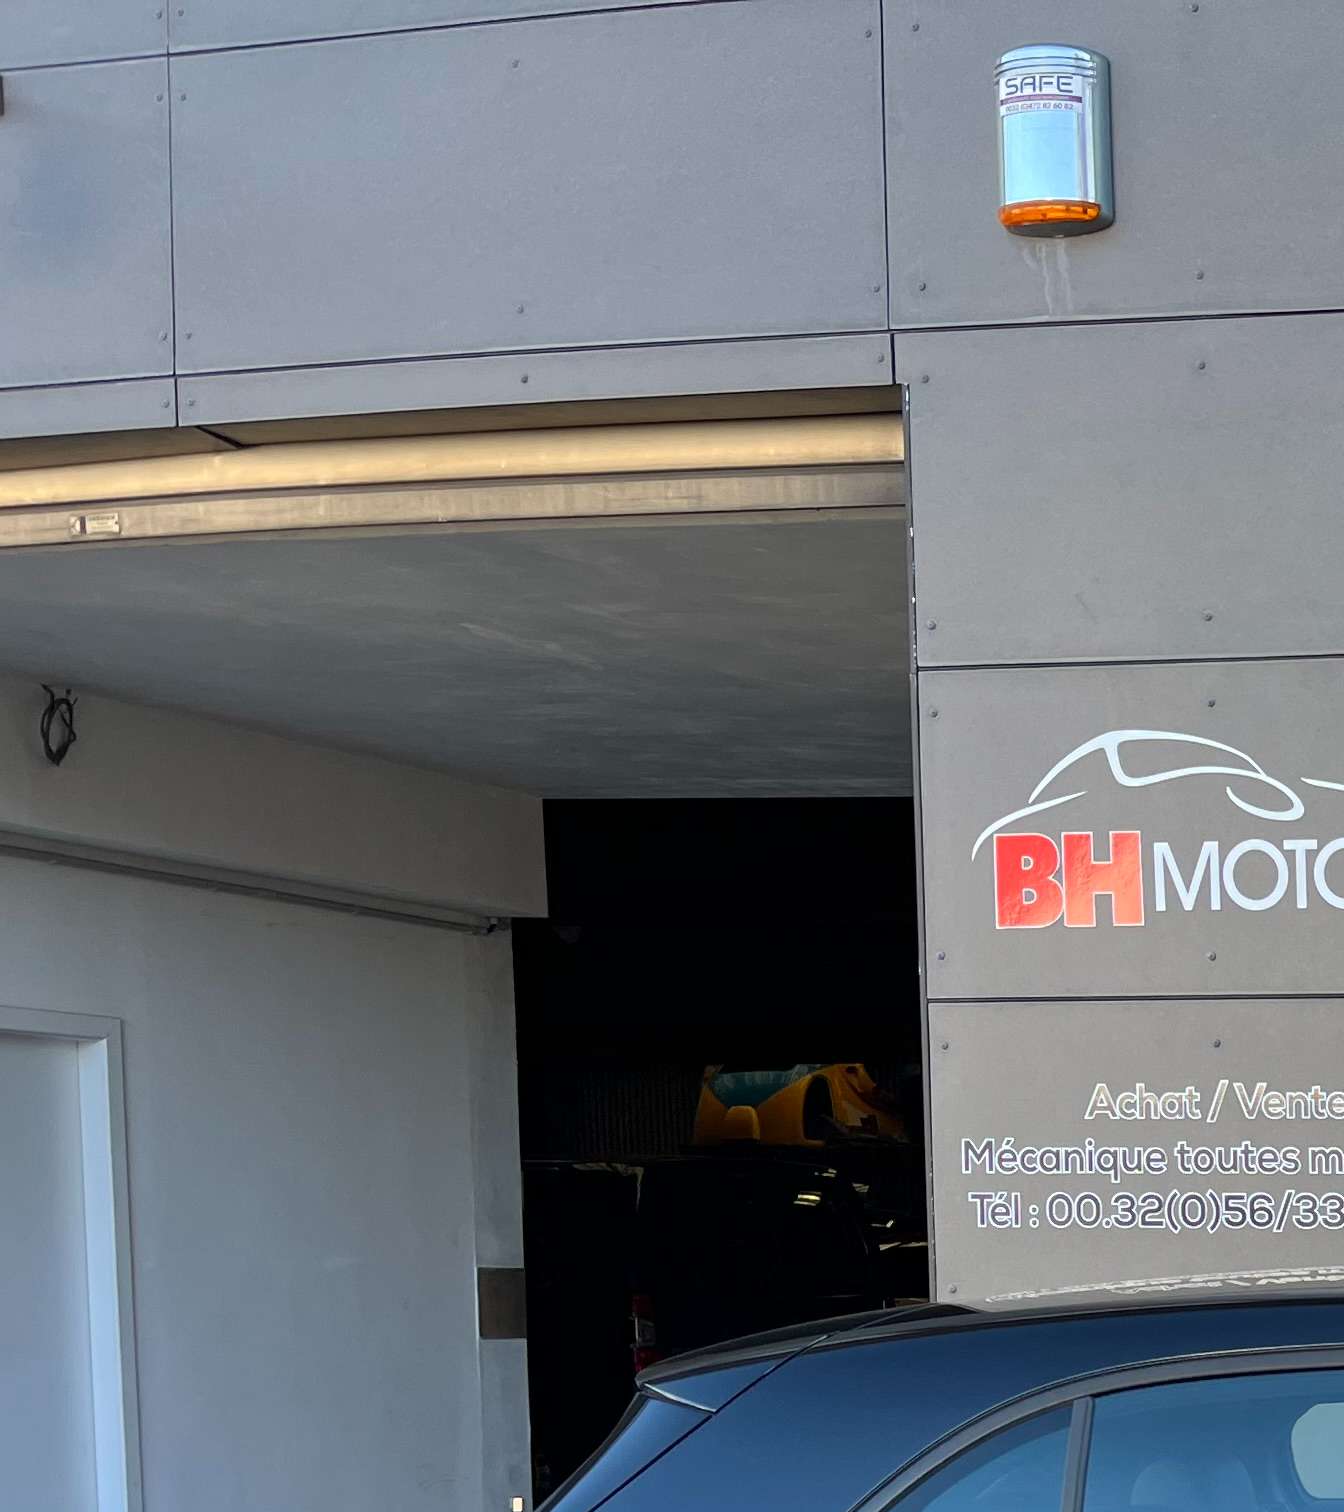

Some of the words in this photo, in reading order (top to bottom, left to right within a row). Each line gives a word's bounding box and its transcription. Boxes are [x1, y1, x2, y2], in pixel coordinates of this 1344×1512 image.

[1005, 75, 1073, 96] SAFE
[994, 831, 1145, 930] BH
[1084, 1083, 1202, 1120] Achat
[961, 1137, 1168, 1184] Mécanique
[1175, 1141, 1302, 1175] toutes
